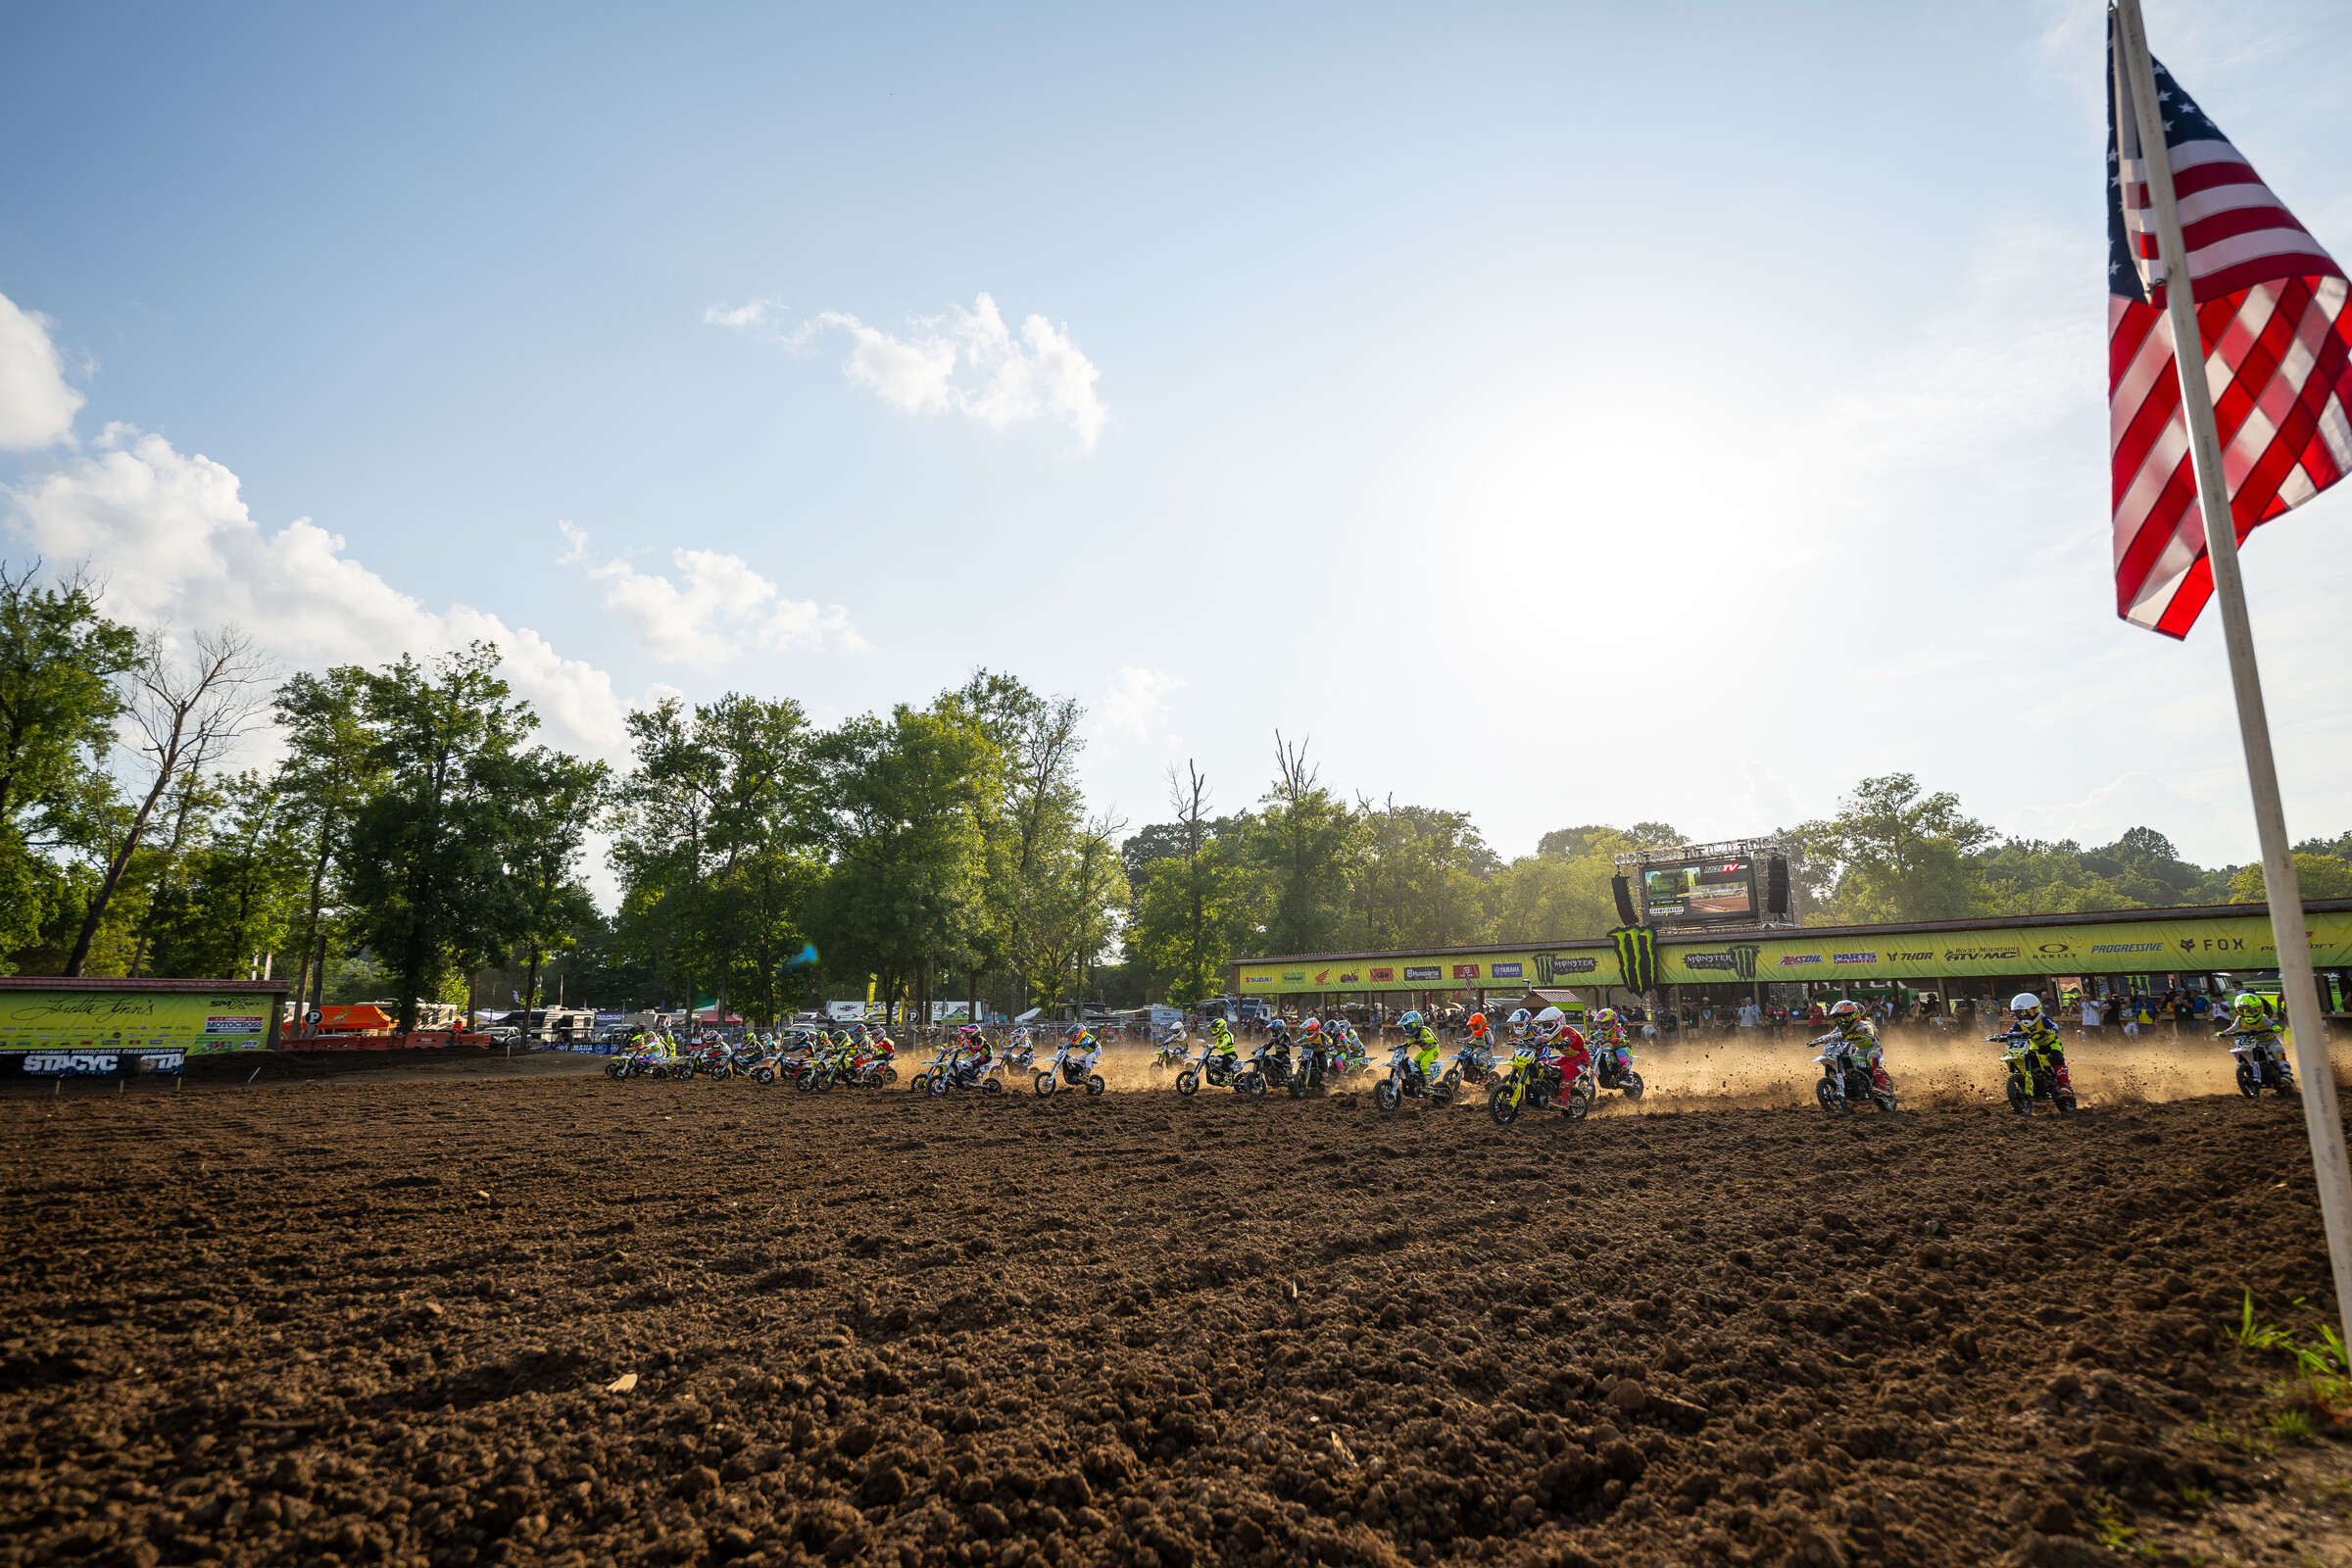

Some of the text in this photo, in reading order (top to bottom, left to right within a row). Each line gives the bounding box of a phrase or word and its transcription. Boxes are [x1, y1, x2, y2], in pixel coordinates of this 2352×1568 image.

[2091, 942, 2164, 954] PROGRESSIVE
[2203, 938, 2245, 952] FOX
[1687, 955, 1733, 963] MONSTER
[1778, 955, 1824, 966] AMSOIL
[1900, 952, 1935, 961] THOR
[1554, 959, 1594, 968] MONSTER
[210, 998, 249, 1009] SMX
[310, 1010, 318, 1023] P
[909, 1012, 917, 1022] P
[23, 1054, 119, 1071] STACYC
